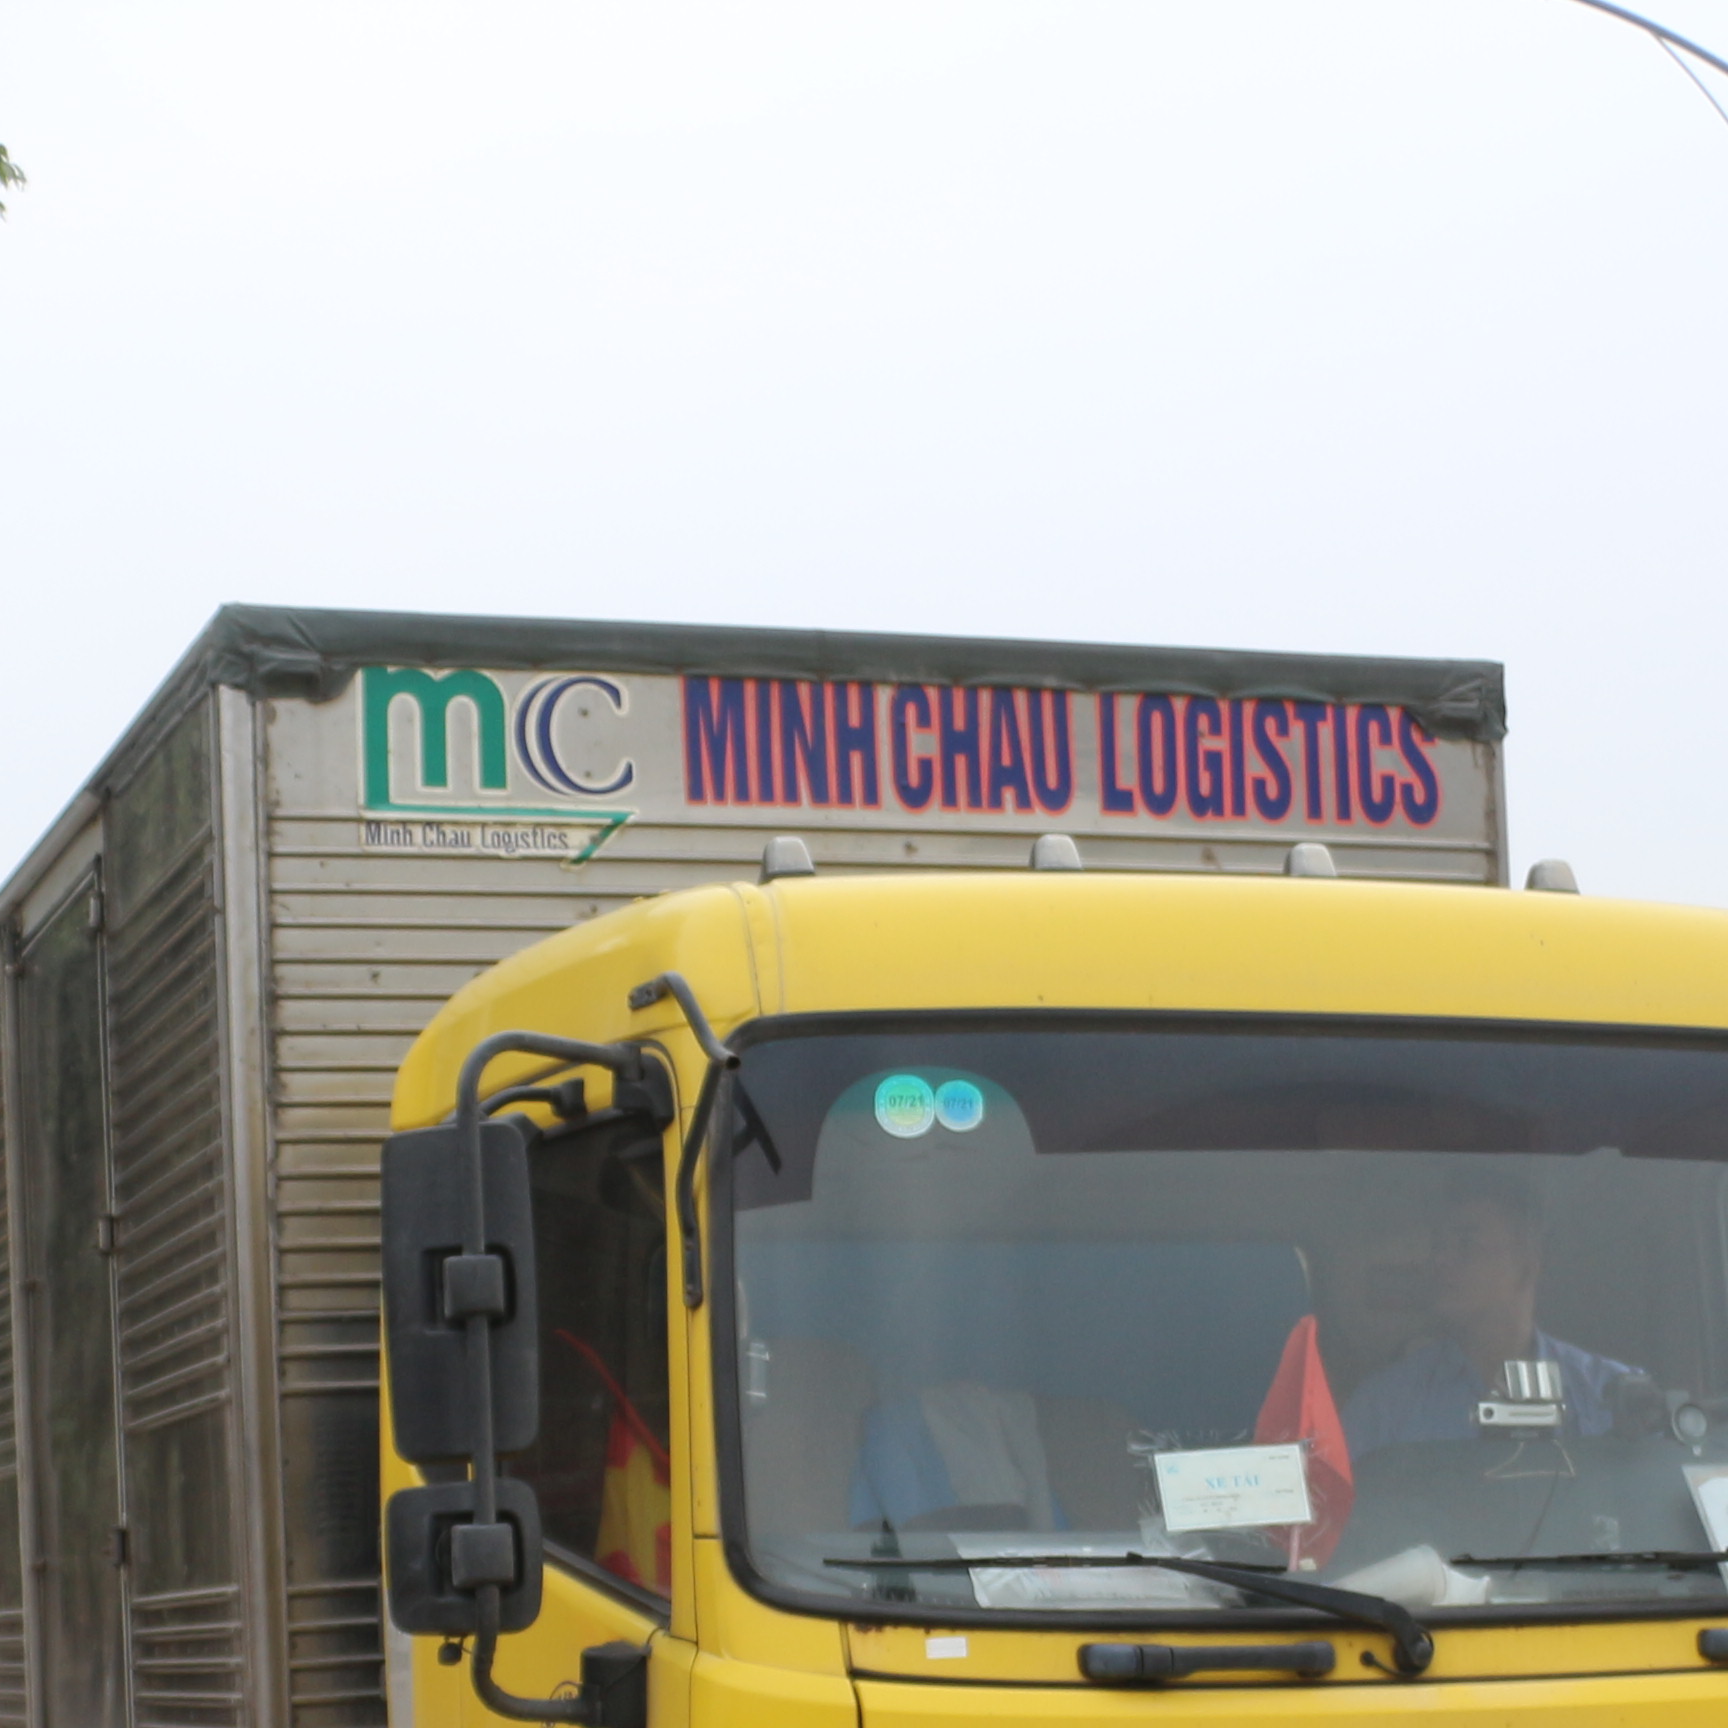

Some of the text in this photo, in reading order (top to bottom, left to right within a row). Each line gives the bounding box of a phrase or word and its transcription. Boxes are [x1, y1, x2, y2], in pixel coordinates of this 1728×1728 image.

[680, 675, 1443, 830] MINH CHAU LOGISTICS
[364, 820, 569, 854] Minh Chau Logistics
[888, 1095, 924, 1108] 07/21
[1205, 1476, 1228, 1490] XE
